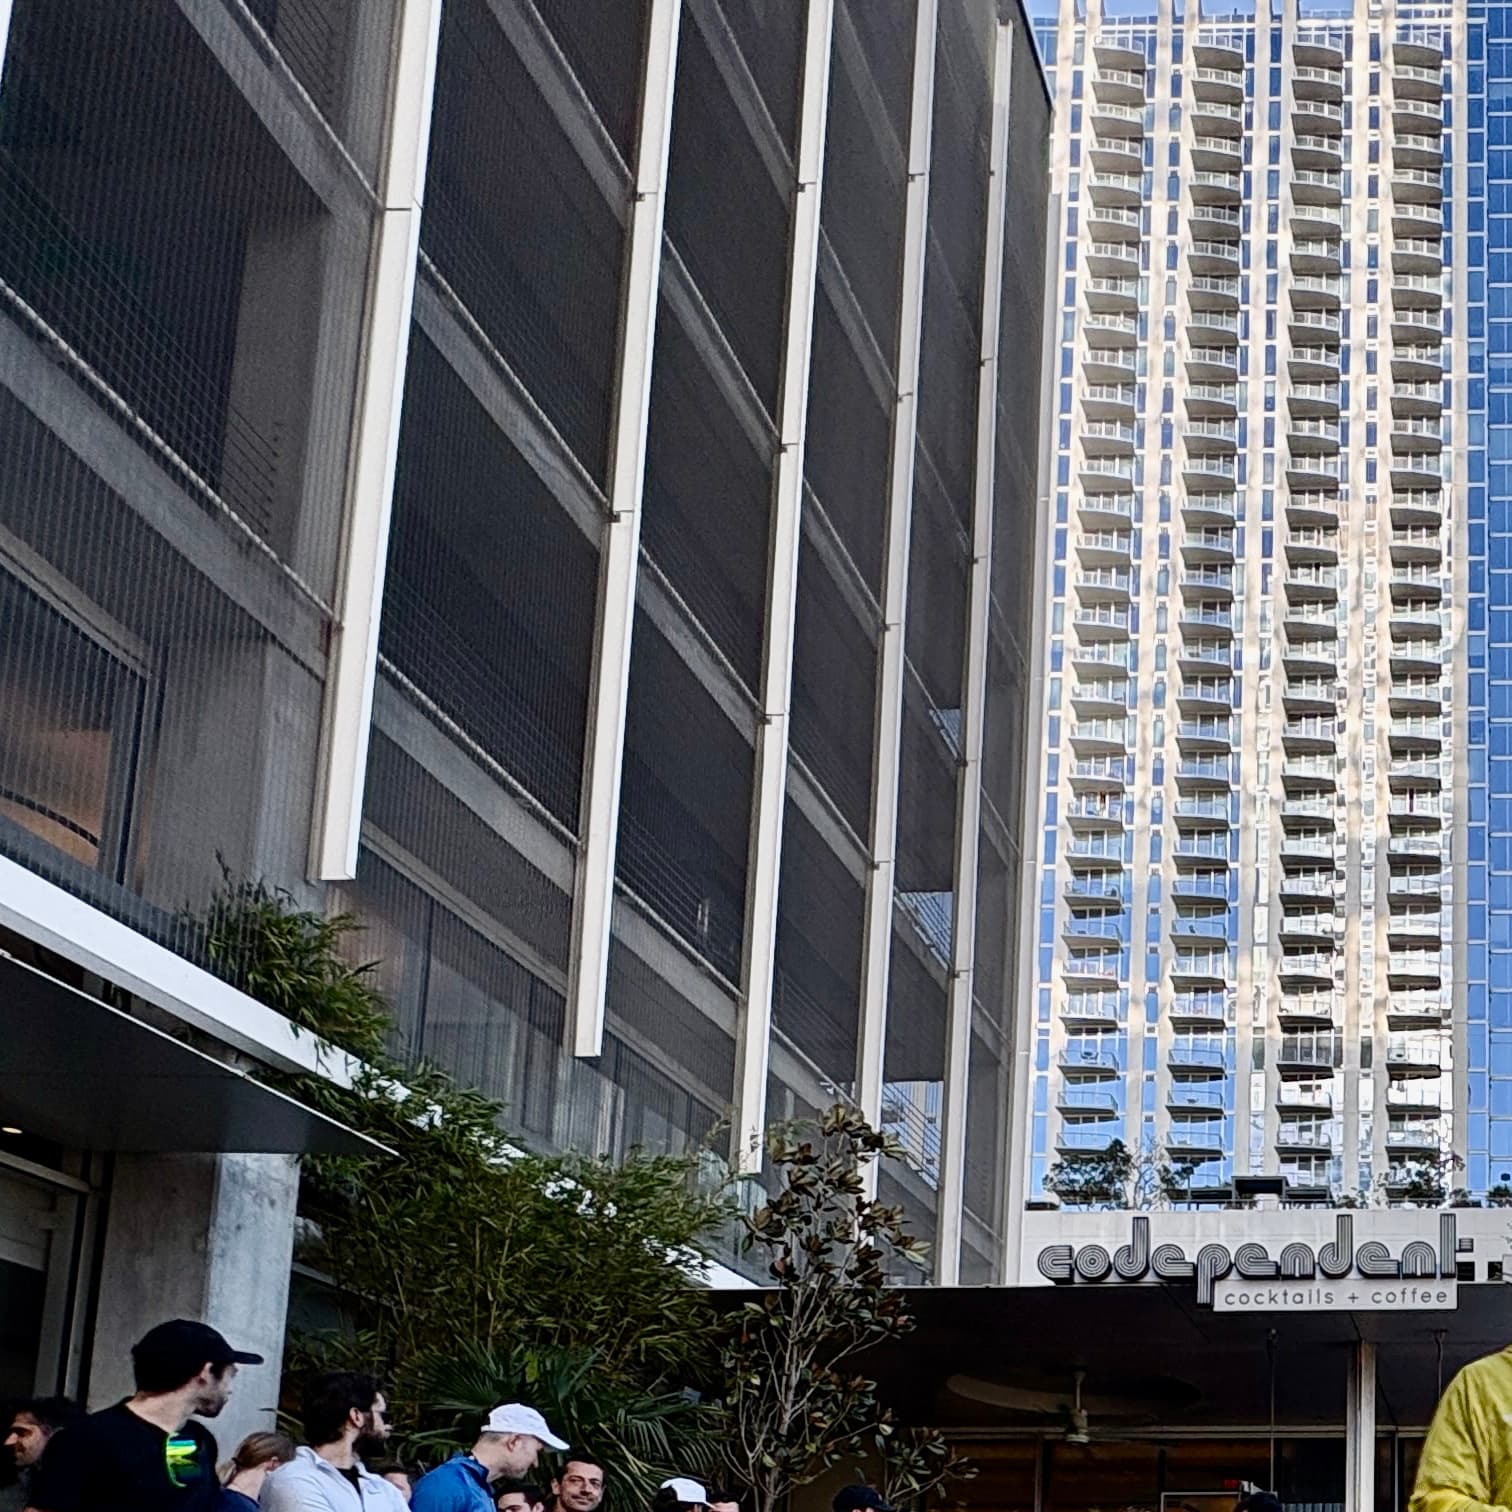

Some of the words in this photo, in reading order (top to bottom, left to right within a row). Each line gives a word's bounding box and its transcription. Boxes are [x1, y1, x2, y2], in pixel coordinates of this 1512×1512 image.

[1037, 1213, 1474, 1307] codependent
[1224, 1288, 1335, 1305] cocktails
[1347, 1291, 1360, 1303] +
[1371, 1287, 1449, 1304] coffee
